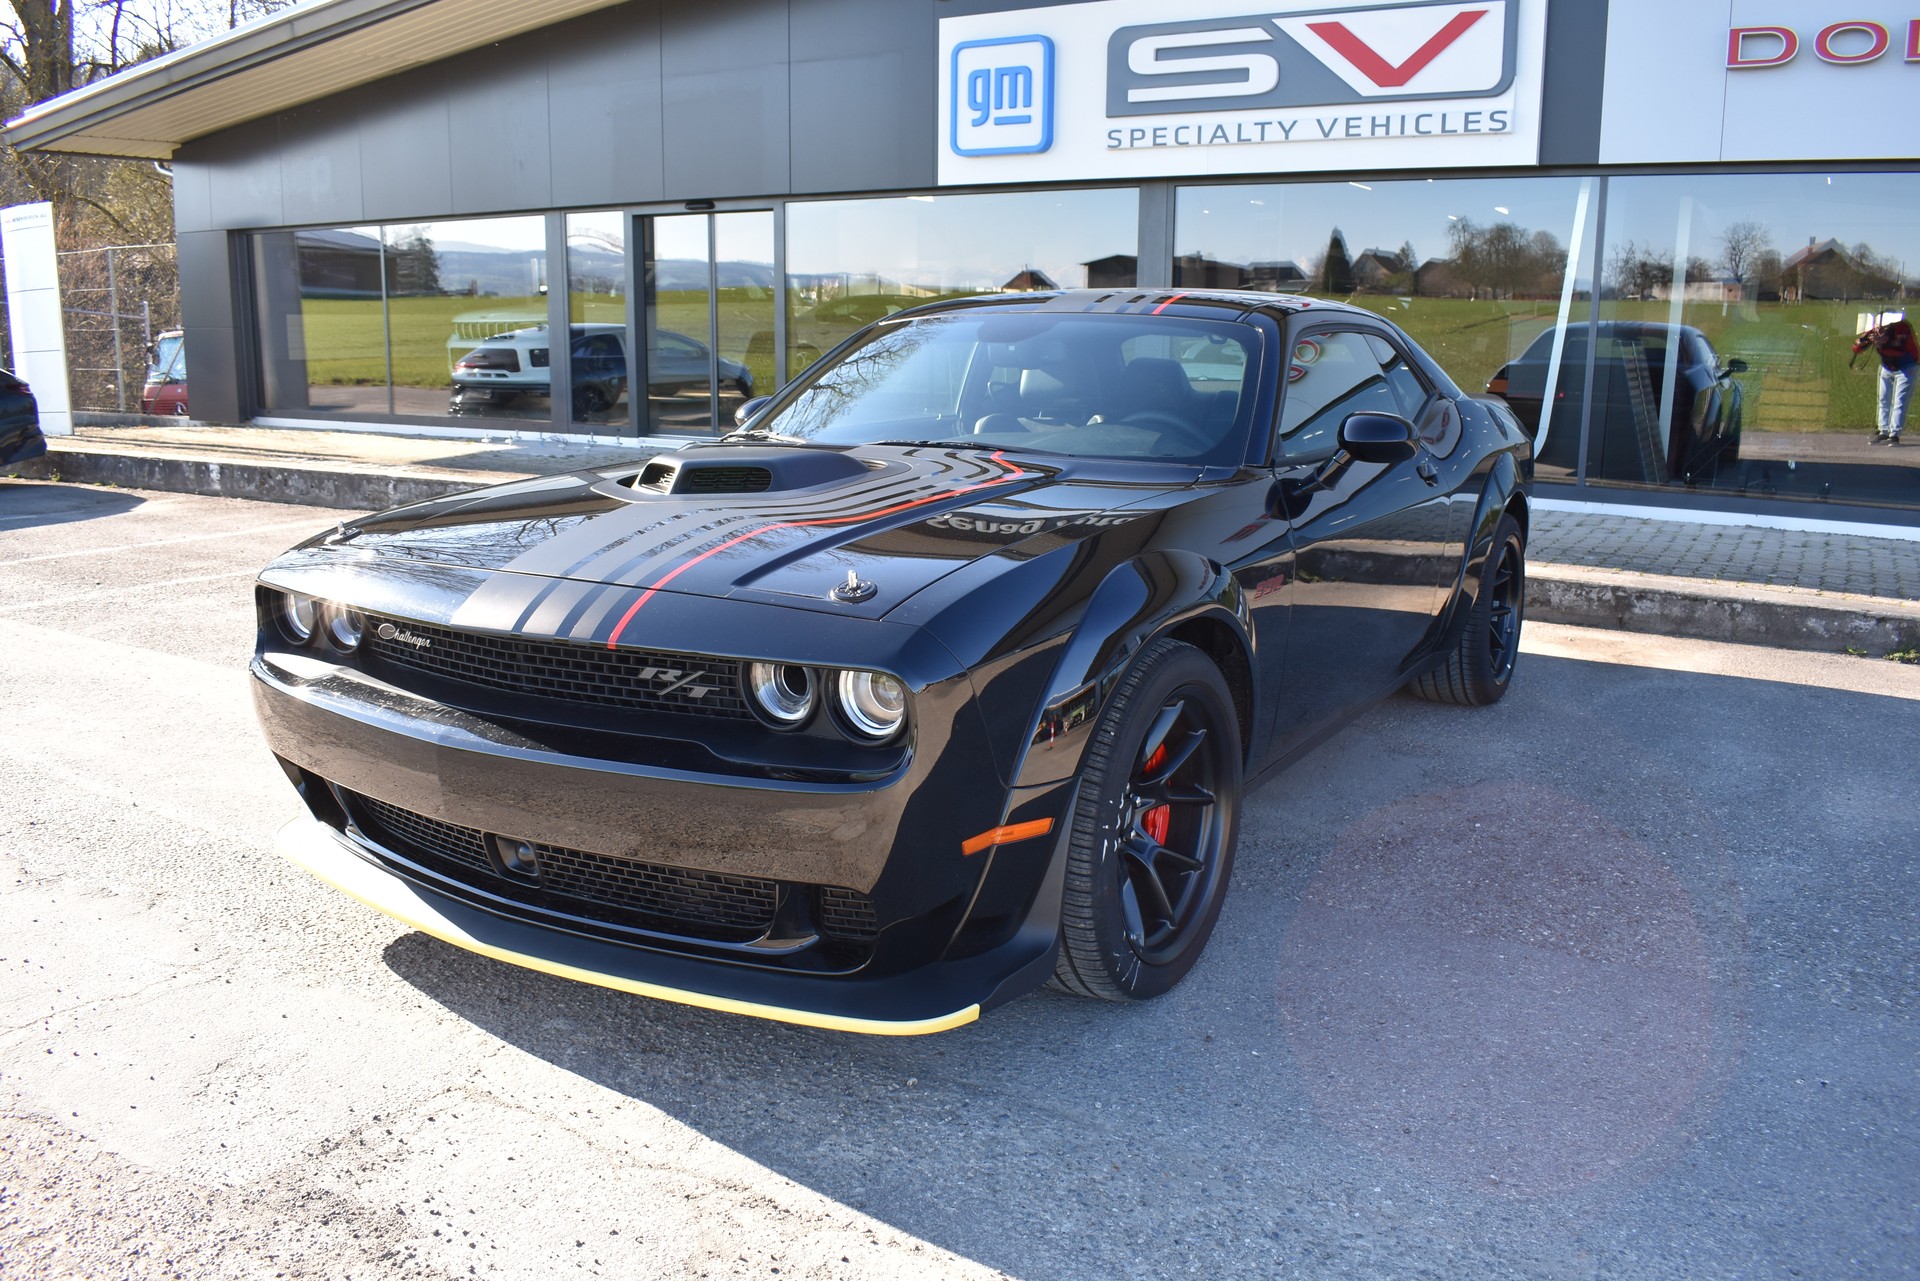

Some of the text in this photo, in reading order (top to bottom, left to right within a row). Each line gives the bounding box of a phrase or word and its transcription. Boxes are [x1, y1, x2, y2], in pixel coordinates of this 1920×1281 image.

[1726, 19, 1920, 69] DO
[967, 65, 1032, 127] gm
[1106, 109, 1509, 149] SPECIALTY VEHICLES
[377, 623, 431, 650] Challenger
[637, 667, 721, 698] R/T
